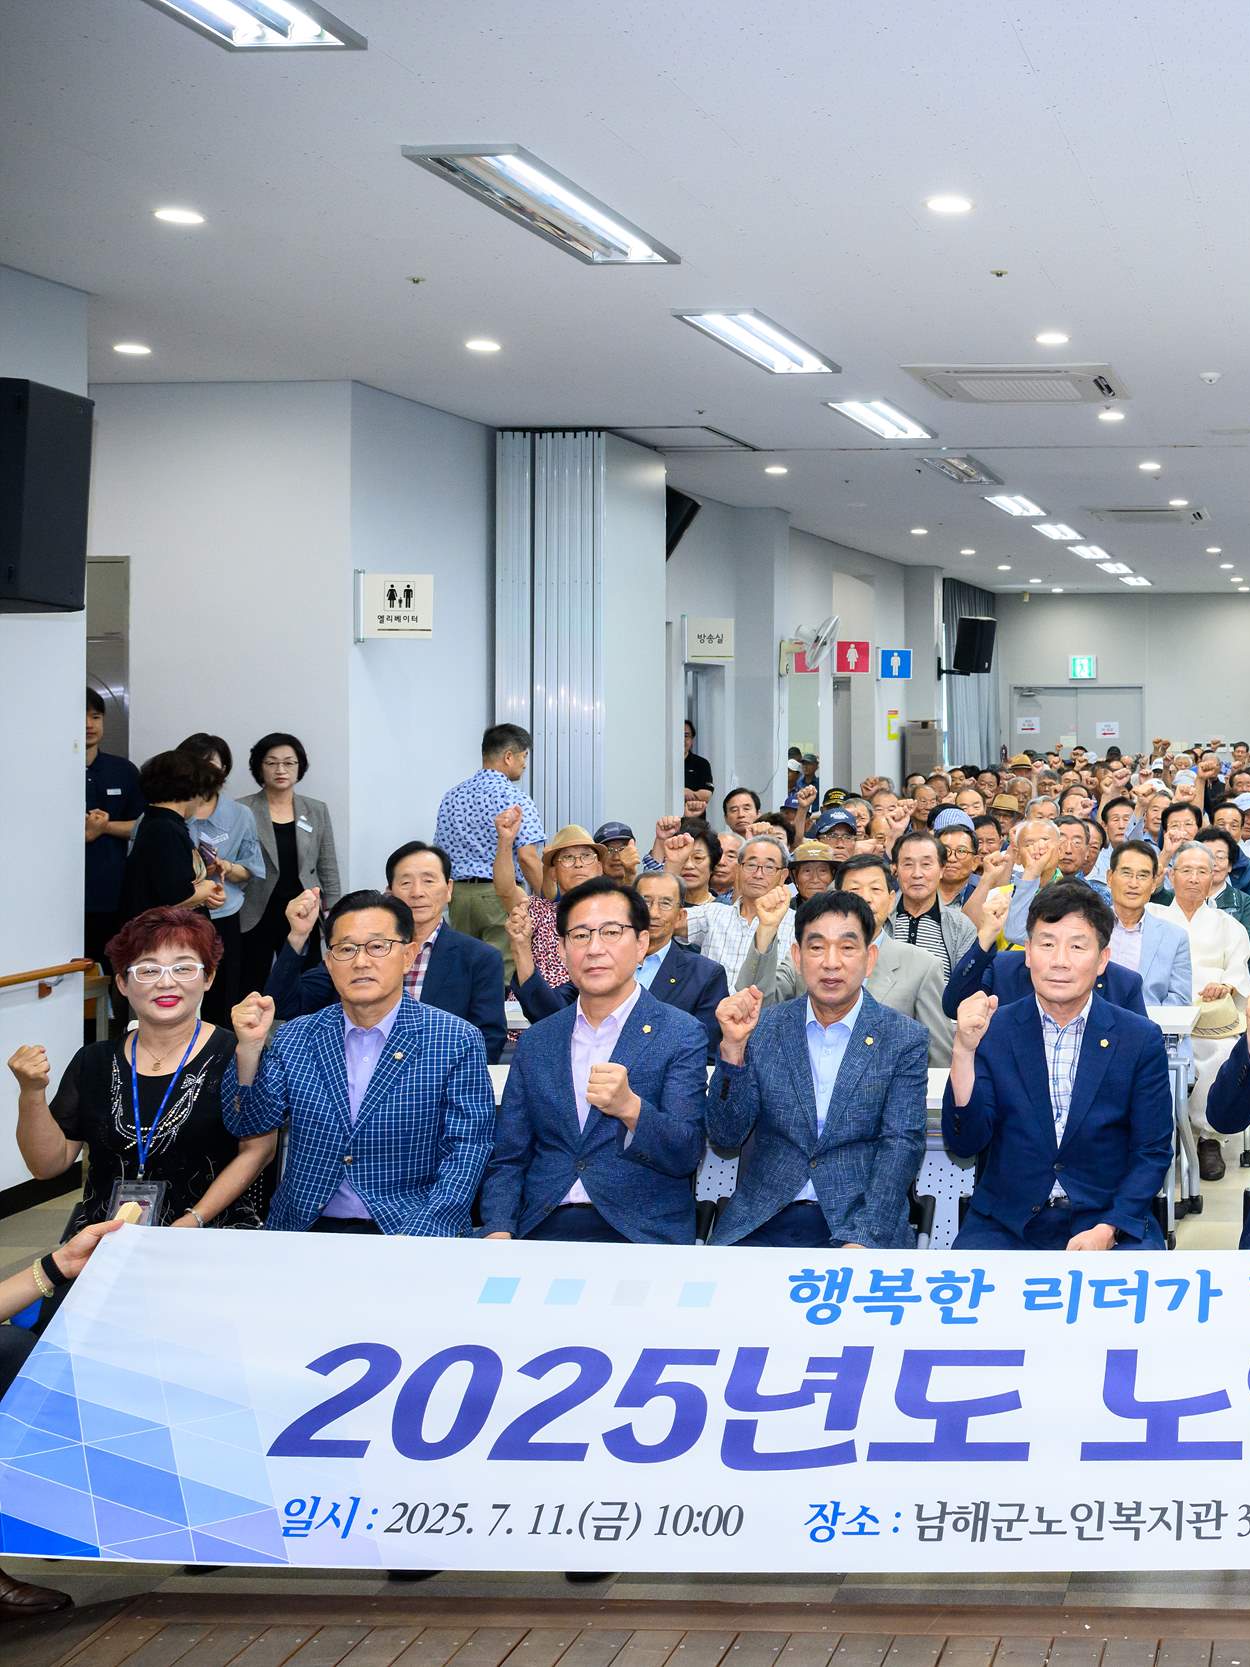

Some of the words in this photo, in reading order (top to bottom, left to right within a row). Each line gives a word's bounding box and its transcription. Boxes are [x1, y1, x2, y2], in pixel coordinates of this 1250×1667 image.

[696, 633, 724, 645] 방송실
[788, 1267, 995, 1326] 행복한
[1023, 1269, 1223, 1324] 리더가
[266, 1343, 1030, 1471] 2025년도
[384, 1502, 473, 1535] 2025.
[489, 1504, 512, 1536] 7.
[654, 1505, 743, 1536] 10:00
[915, 1500, 1228, 1542] 남해군노인복지관
